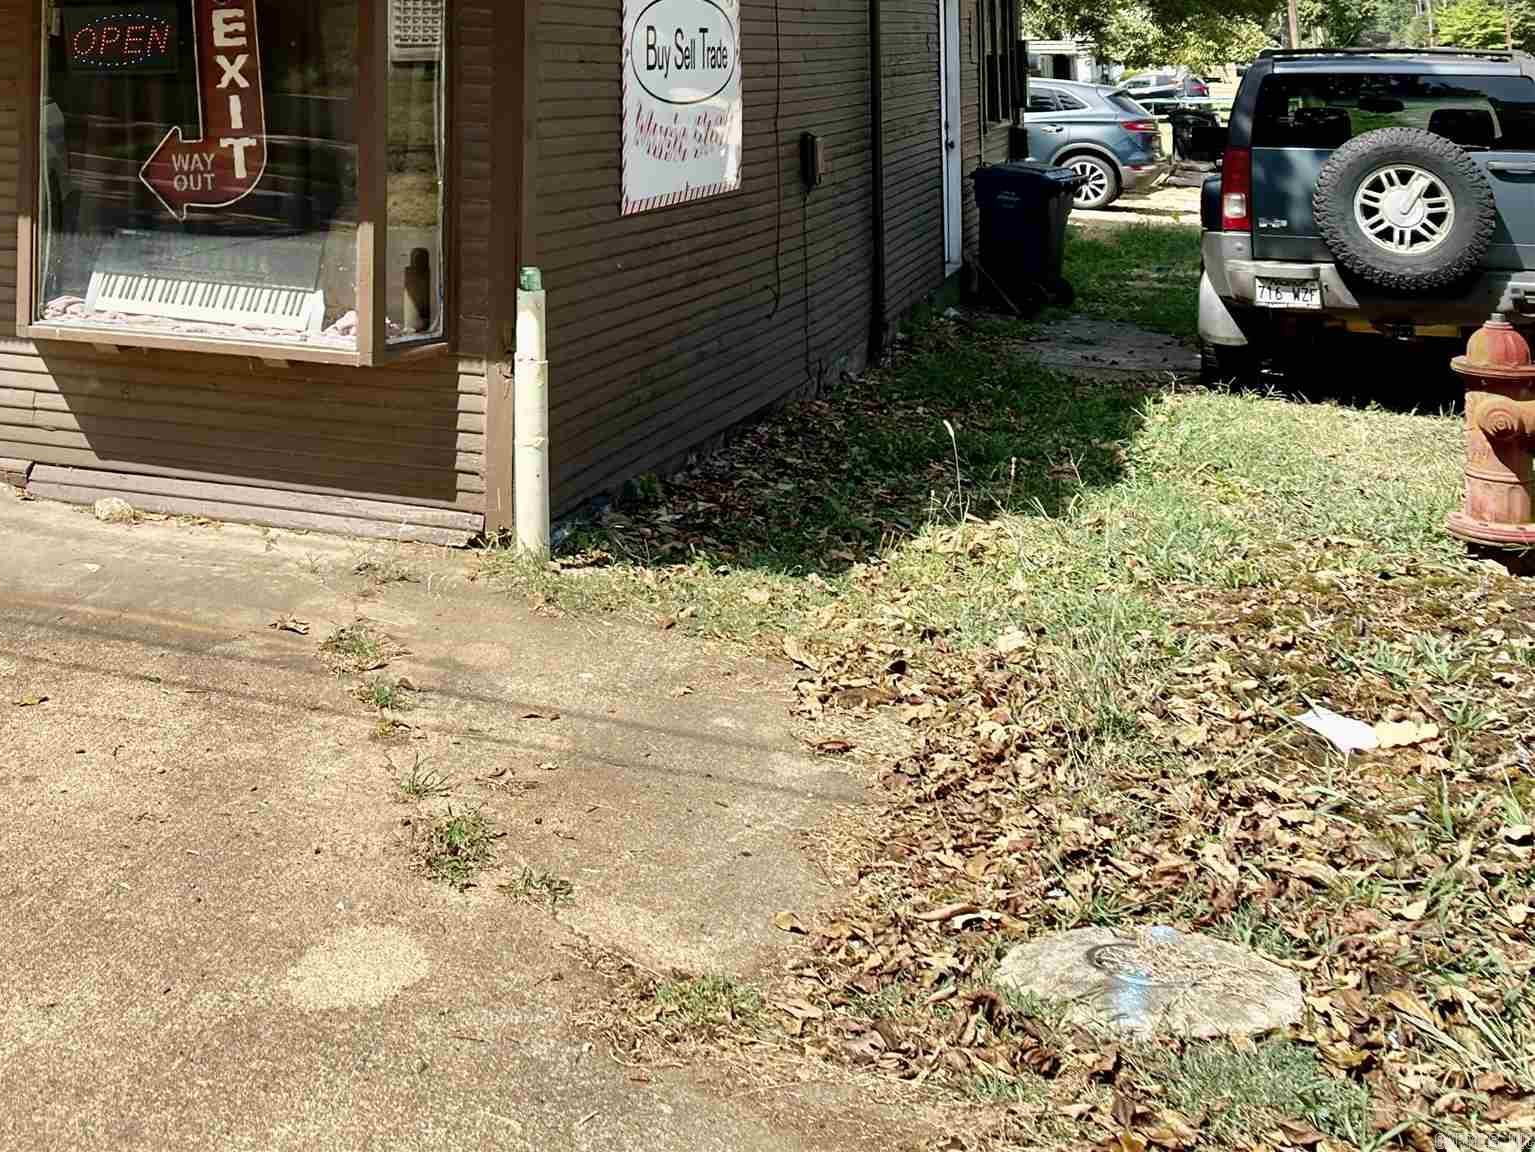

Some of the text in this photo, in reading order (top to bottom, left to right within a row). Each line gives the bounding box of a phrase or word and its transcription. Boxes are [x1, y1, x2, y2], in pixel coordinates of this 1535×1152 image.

[73, 24, 170, 55] OPEN
[646, 25, 728, 78] Buy Sell Trade
[212, 8, 257, 179] EXIT
[171, 152, 216, 172] WAY
[174, 173, 215, 192] OUT
